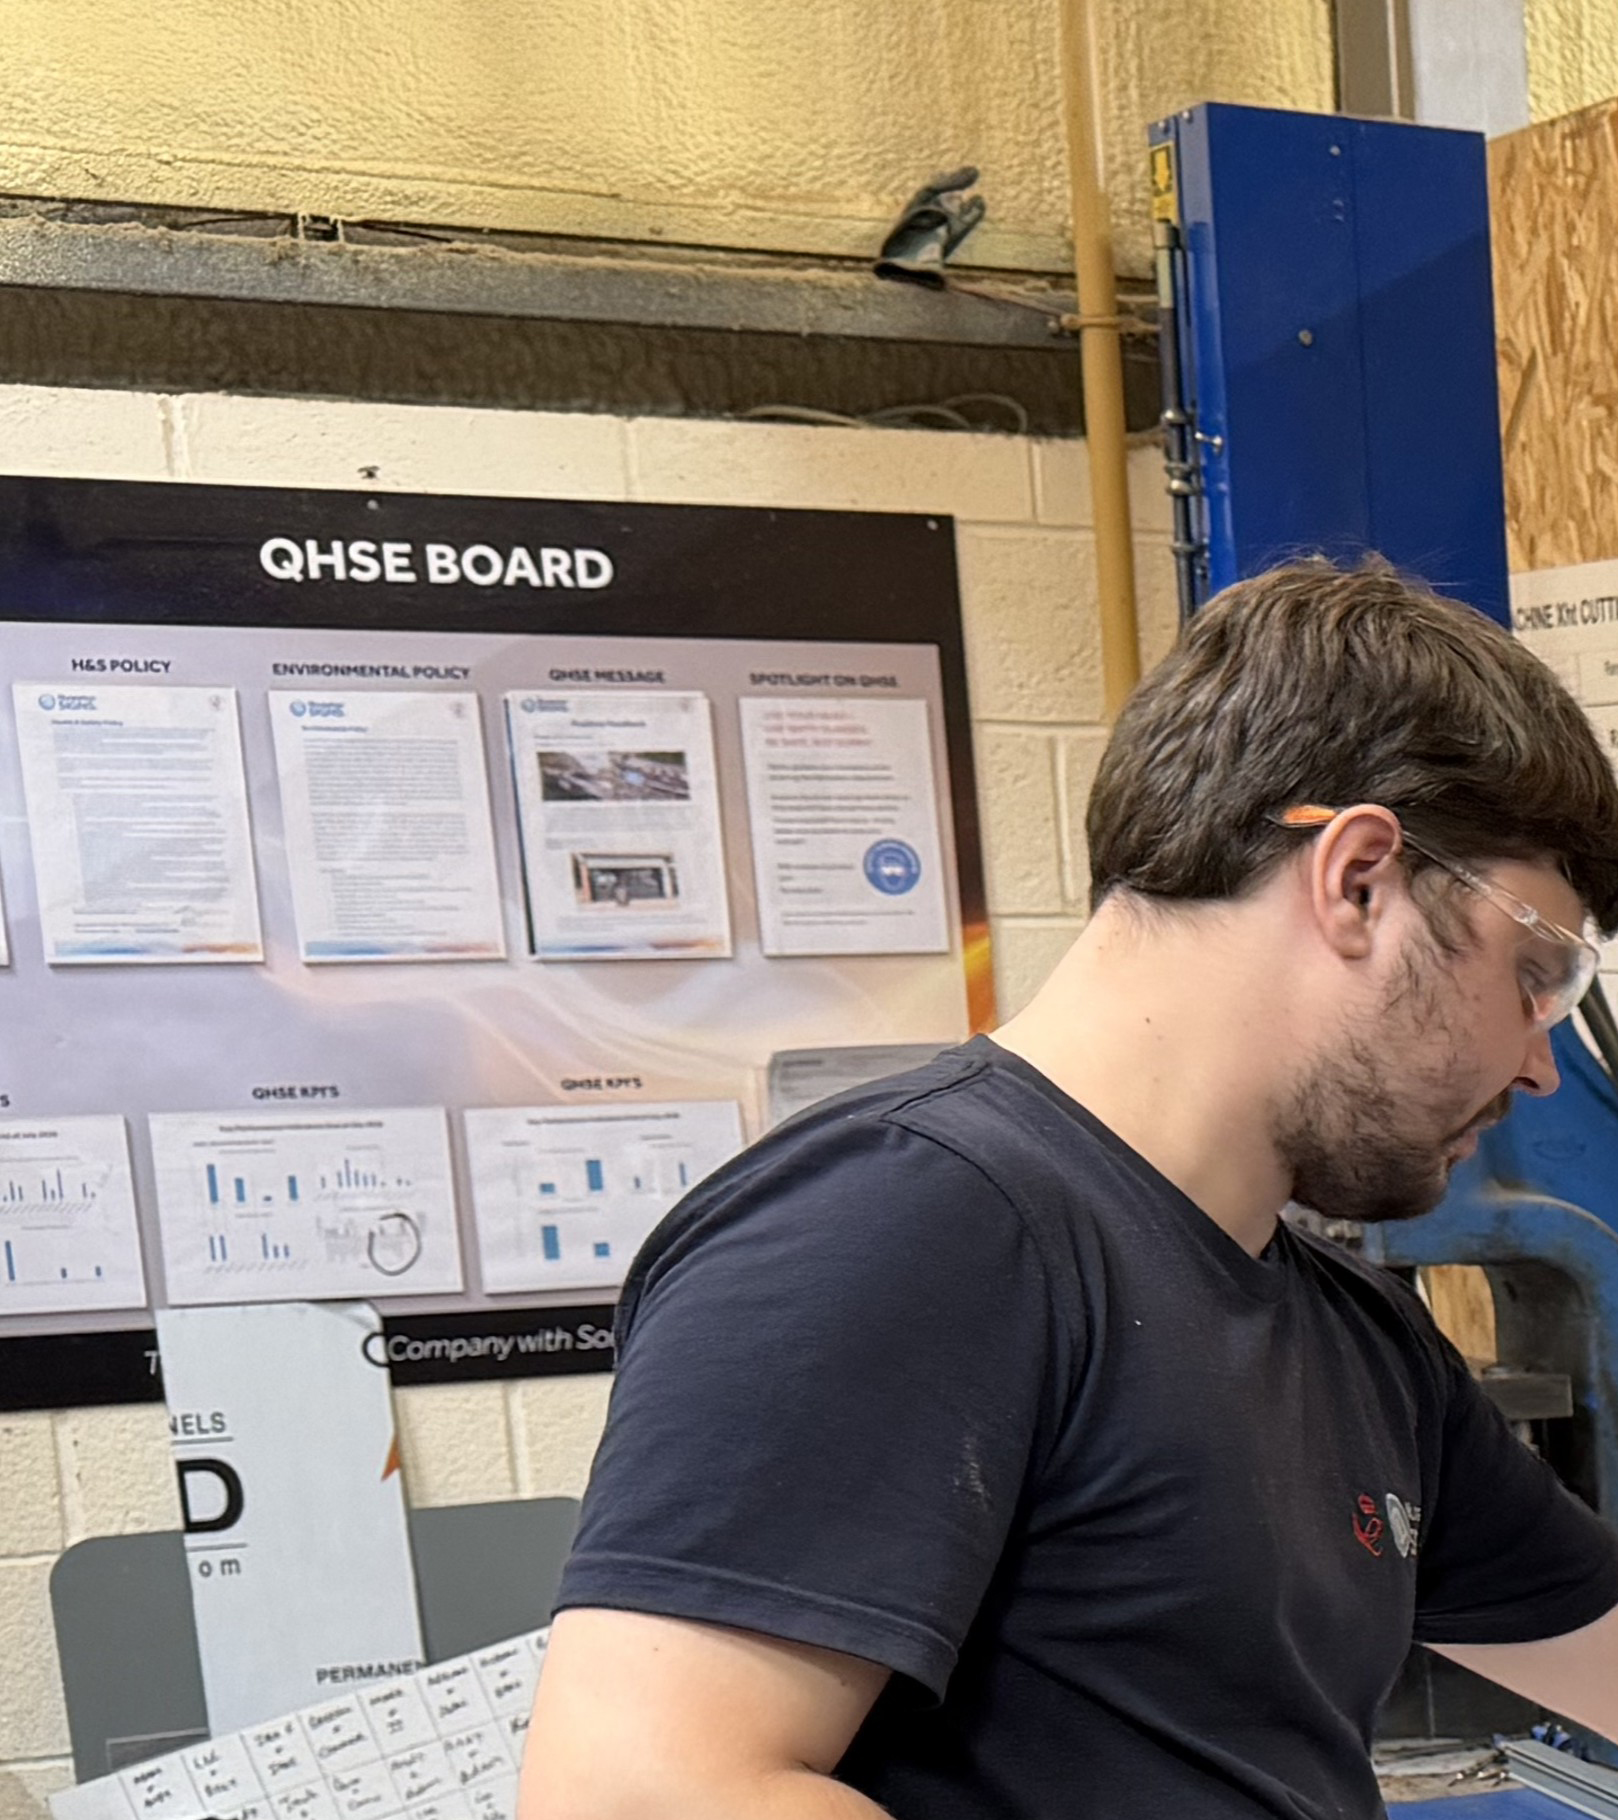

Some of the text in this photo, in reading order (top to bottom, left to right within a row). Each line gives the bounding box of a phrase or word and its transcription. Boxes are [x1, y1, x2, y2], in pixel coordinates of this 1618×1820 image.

[259, 537, 614, 589] QHSE BOARD
[71, 658, 172, 674] H&S POLICY
[272, 662, 471, 680] ENVIRONMENTAL POLICY
[548, 668, 666, 684] QHSE MESSAGE
[749, 672, 831, 687] SPOTLIGHT
[252, 1085, 298, 1100] QHSE
[387, 1323, 614, 1362] Company with So
